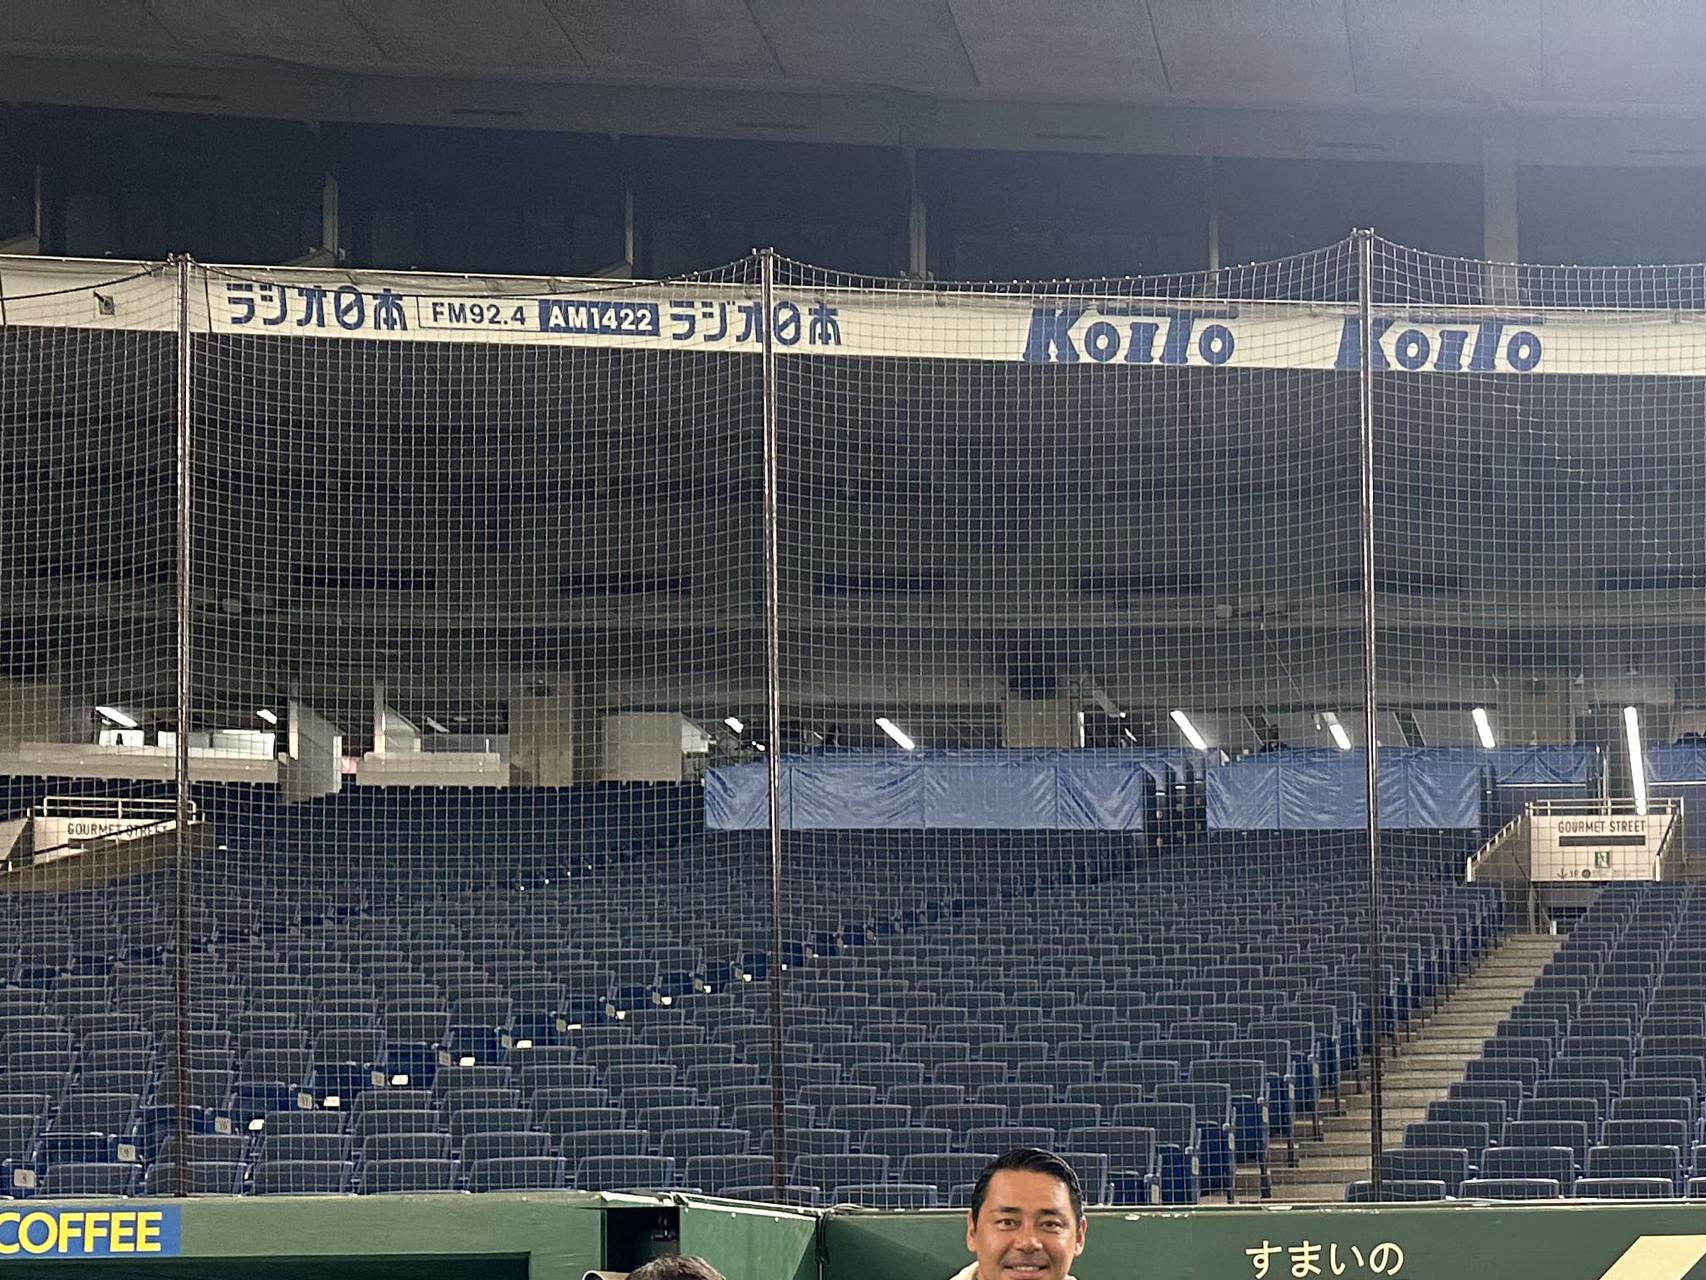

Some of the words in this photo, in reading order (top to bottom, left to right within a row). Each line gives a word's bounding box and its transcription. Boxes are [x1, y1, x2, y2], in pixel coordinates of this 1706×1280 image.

[432, 302, 527, 326] FM92.4
[549, 305, 653, 331] AM1422
[67, 822, 121, 836] GOURMET
[1558, 820, 1605, 833] GOURMET
[1609, 820, 1646, 832] STREET
[0, 1211, 163, 1255] COFFEE
[1245, 1240, 1405, 1280] すまいの
